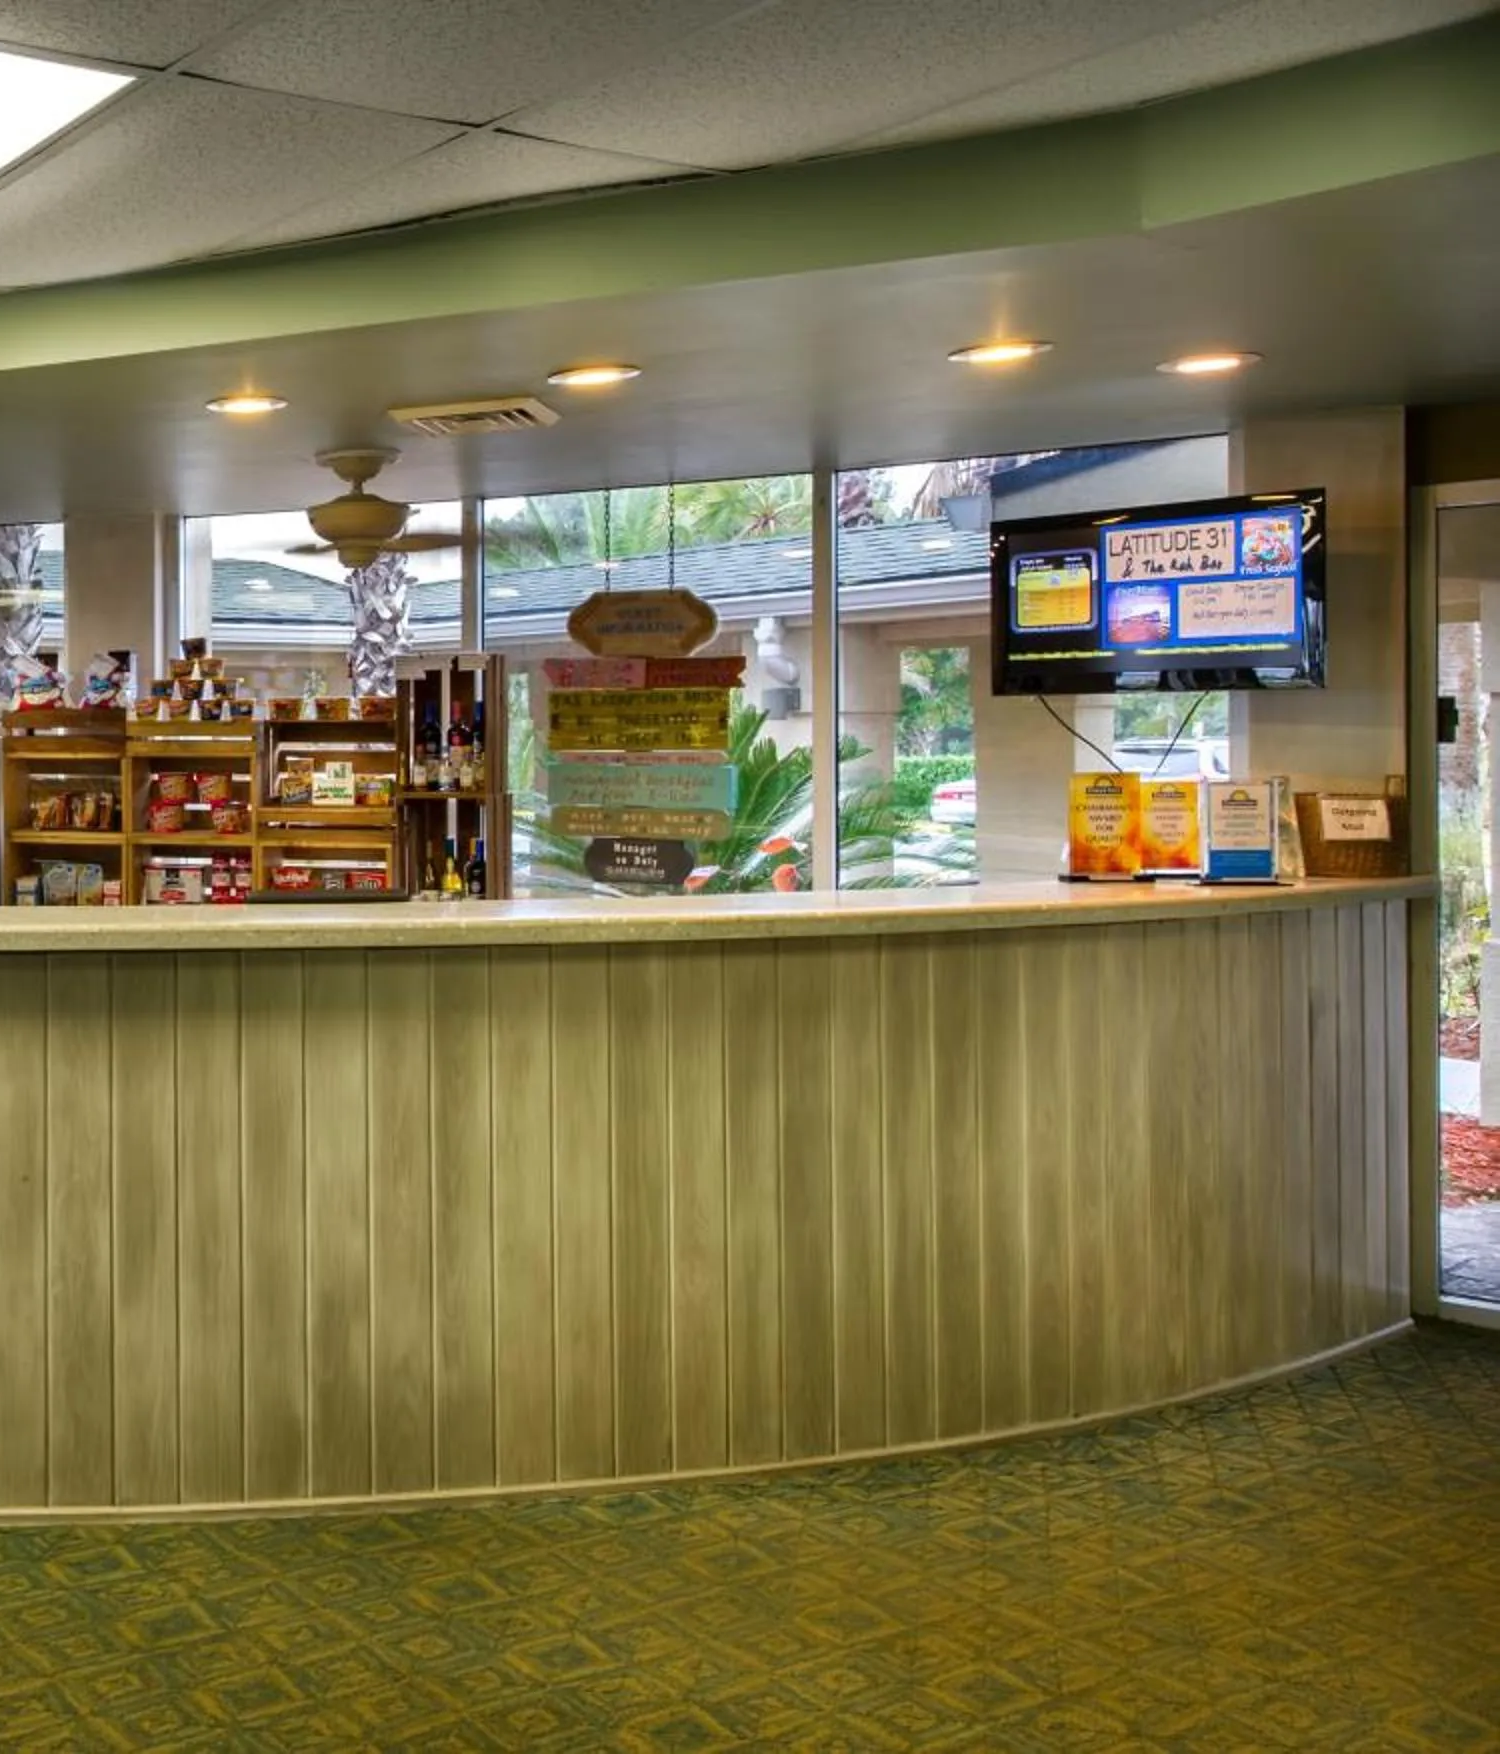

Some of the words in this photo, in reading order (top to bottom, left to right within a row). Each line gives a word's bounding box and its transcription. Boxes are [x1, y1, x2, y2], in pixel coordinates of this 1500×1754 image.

[1109, 529, 1202, 557] LATITUDE
[1206, 527, 1227, 549] 31
[1142, 559, 1165, 574] The
[1200, 554, 1223, 571] Bar
[613, 841, 658, 856] Manager
[633, 855, 658, 868] Duty
